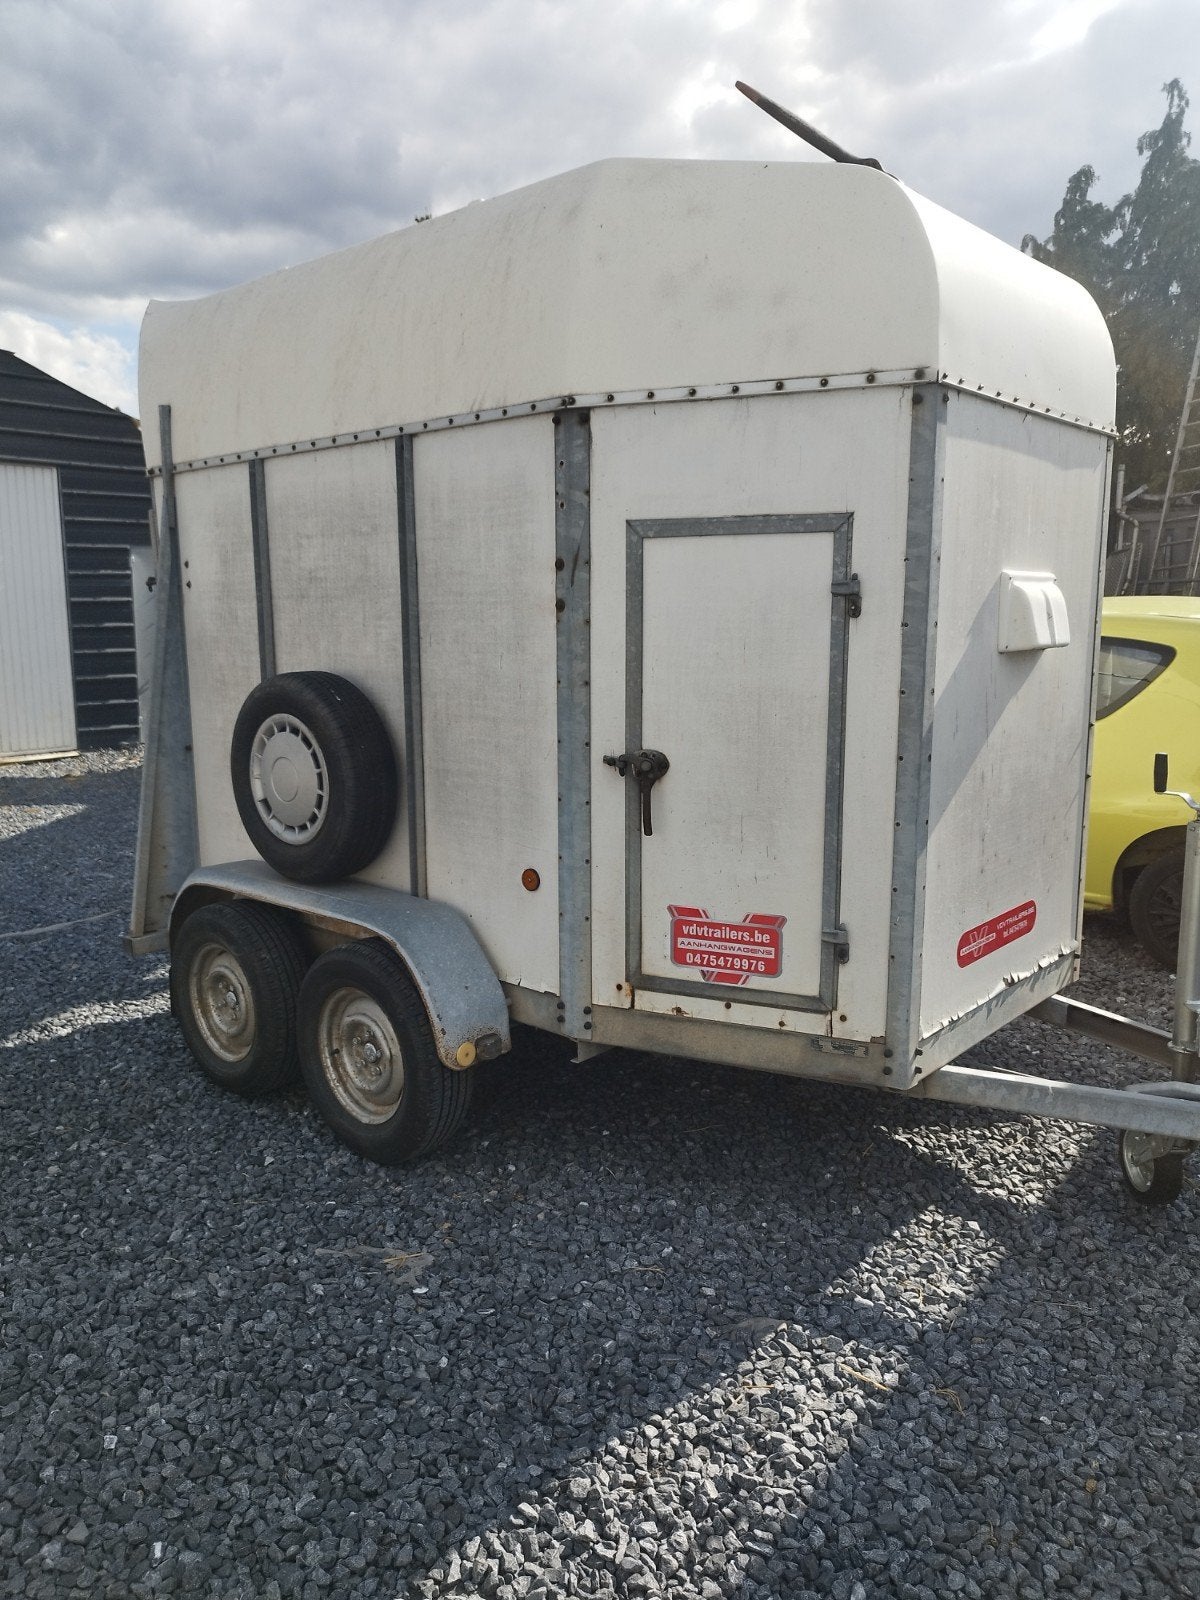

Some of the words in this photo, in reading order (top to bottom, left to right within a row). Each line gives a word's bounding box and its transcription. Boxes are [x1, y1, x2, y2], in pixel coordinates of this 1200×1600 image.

[682, 923, 771, 943] vdvtrailers.be
[679, 940, 773, 956] AANHANGWAGENS
[686, 952, 765, 972] 0475479976
